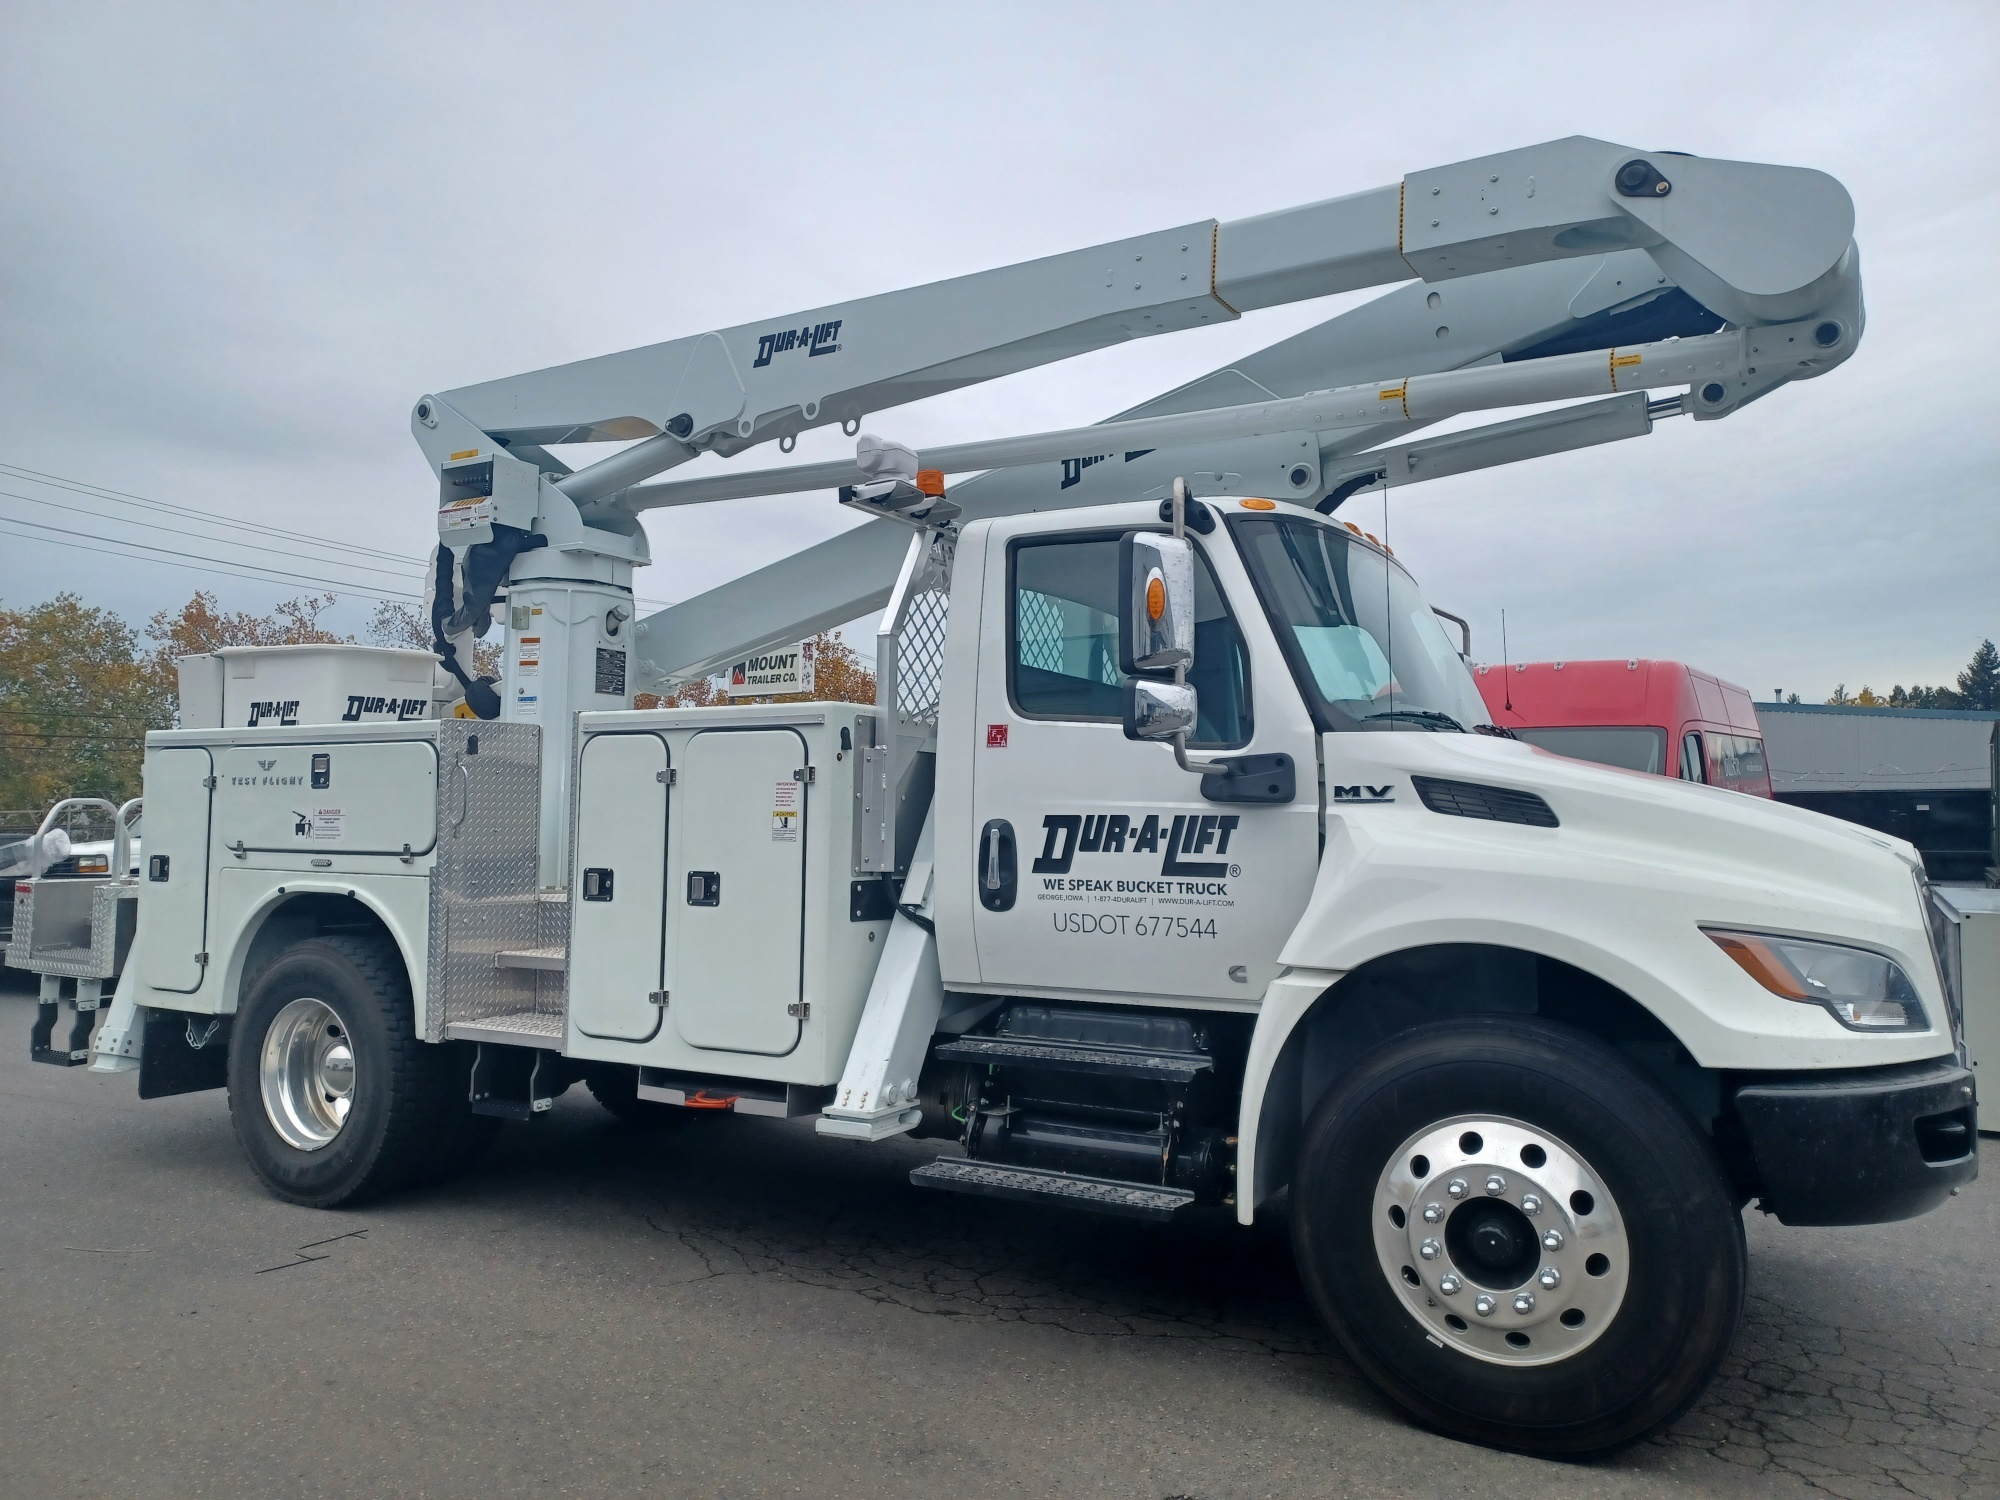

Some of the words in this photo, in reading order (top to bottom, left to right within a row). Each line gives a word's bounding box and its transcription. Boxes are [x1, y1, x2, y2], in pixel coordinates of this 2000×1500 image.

[747, 653, 798, 672] MOUNT
[747, 673, 781, 685] TRAILER
[782, 672, 797, 684] CO.
[231, 776, 257, 786] TEST
[262, 776, 303, 786] FLIGHT
[1333, 784, 1396, 799] MV
[1043, 878, 1065, 891] WE
[1068, 879, 1114, 892] SPEAK
[1116, 880, 1174, 894] BUCKET
[1176, 882, 1228, 896] TRUCK
[1093, 895, 1148, 904] 1-877-4DURALIFT
[1158, 897, 1235, 907] WWW.DUR-A-LIFT.COM
[1053, 912, 1131, 935] USDOT
[1135, 915, 1218, 939] 677544
